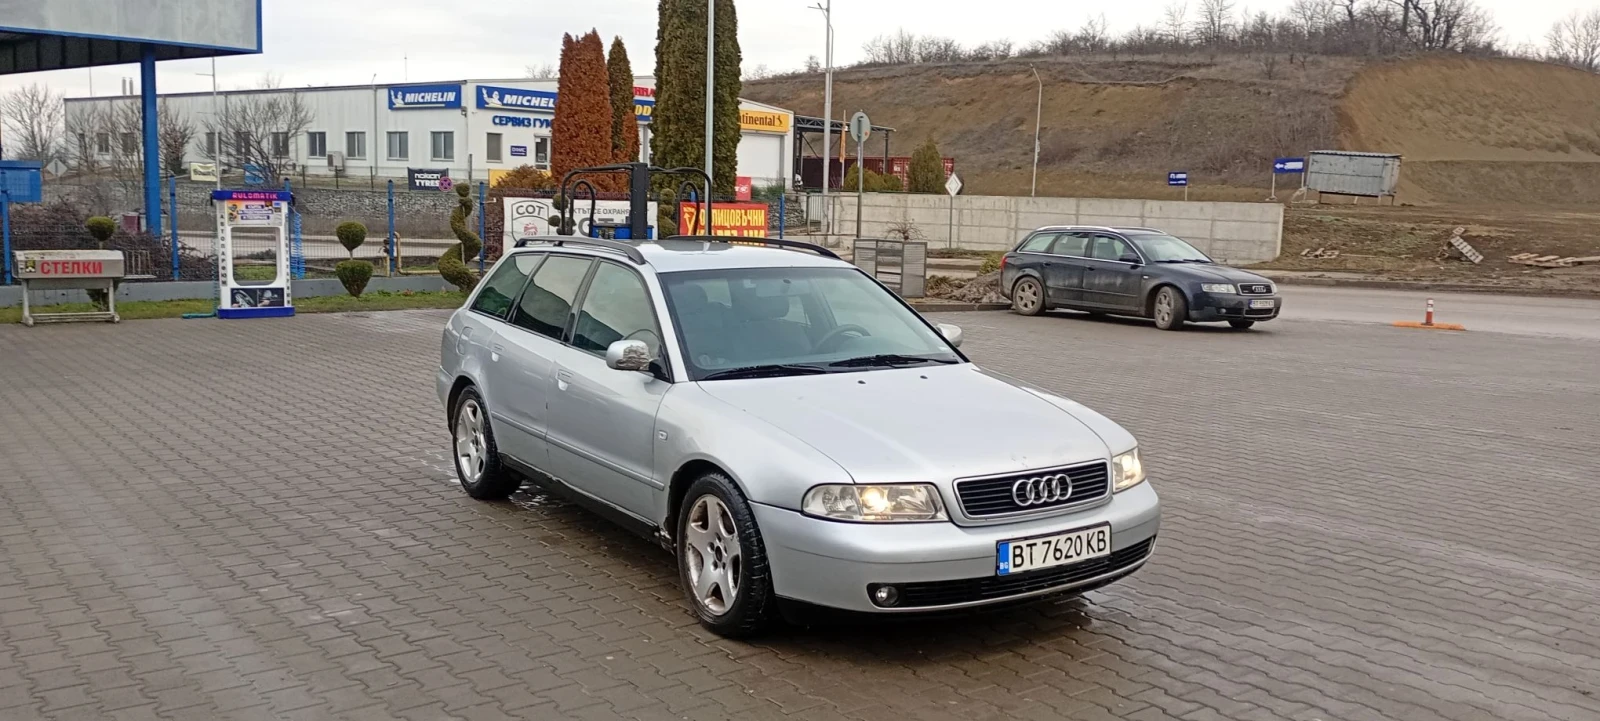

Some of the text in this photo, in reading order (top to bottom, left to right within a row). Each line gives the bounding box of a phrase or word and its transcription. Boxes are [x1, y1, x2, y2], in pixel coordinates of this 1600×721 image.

[404, 91, 456, 103] MICHELIN
[503, 94, 555, 108] MICHEL
[492, 115, 553, 129] СЕРВИЗ ГУМ
[415, 179, 440, 187] TYRES
[603, 207, 630, 215] ОХРАНЯ
[699, 208, 765, 229] ОЛИЦОВЪЧНИ
[40, 261, 103, 275] СТЕЛКИ
[1012, 529, 1107, 569] BT 7620 KB
[999, 561, 1009, 570] BG
